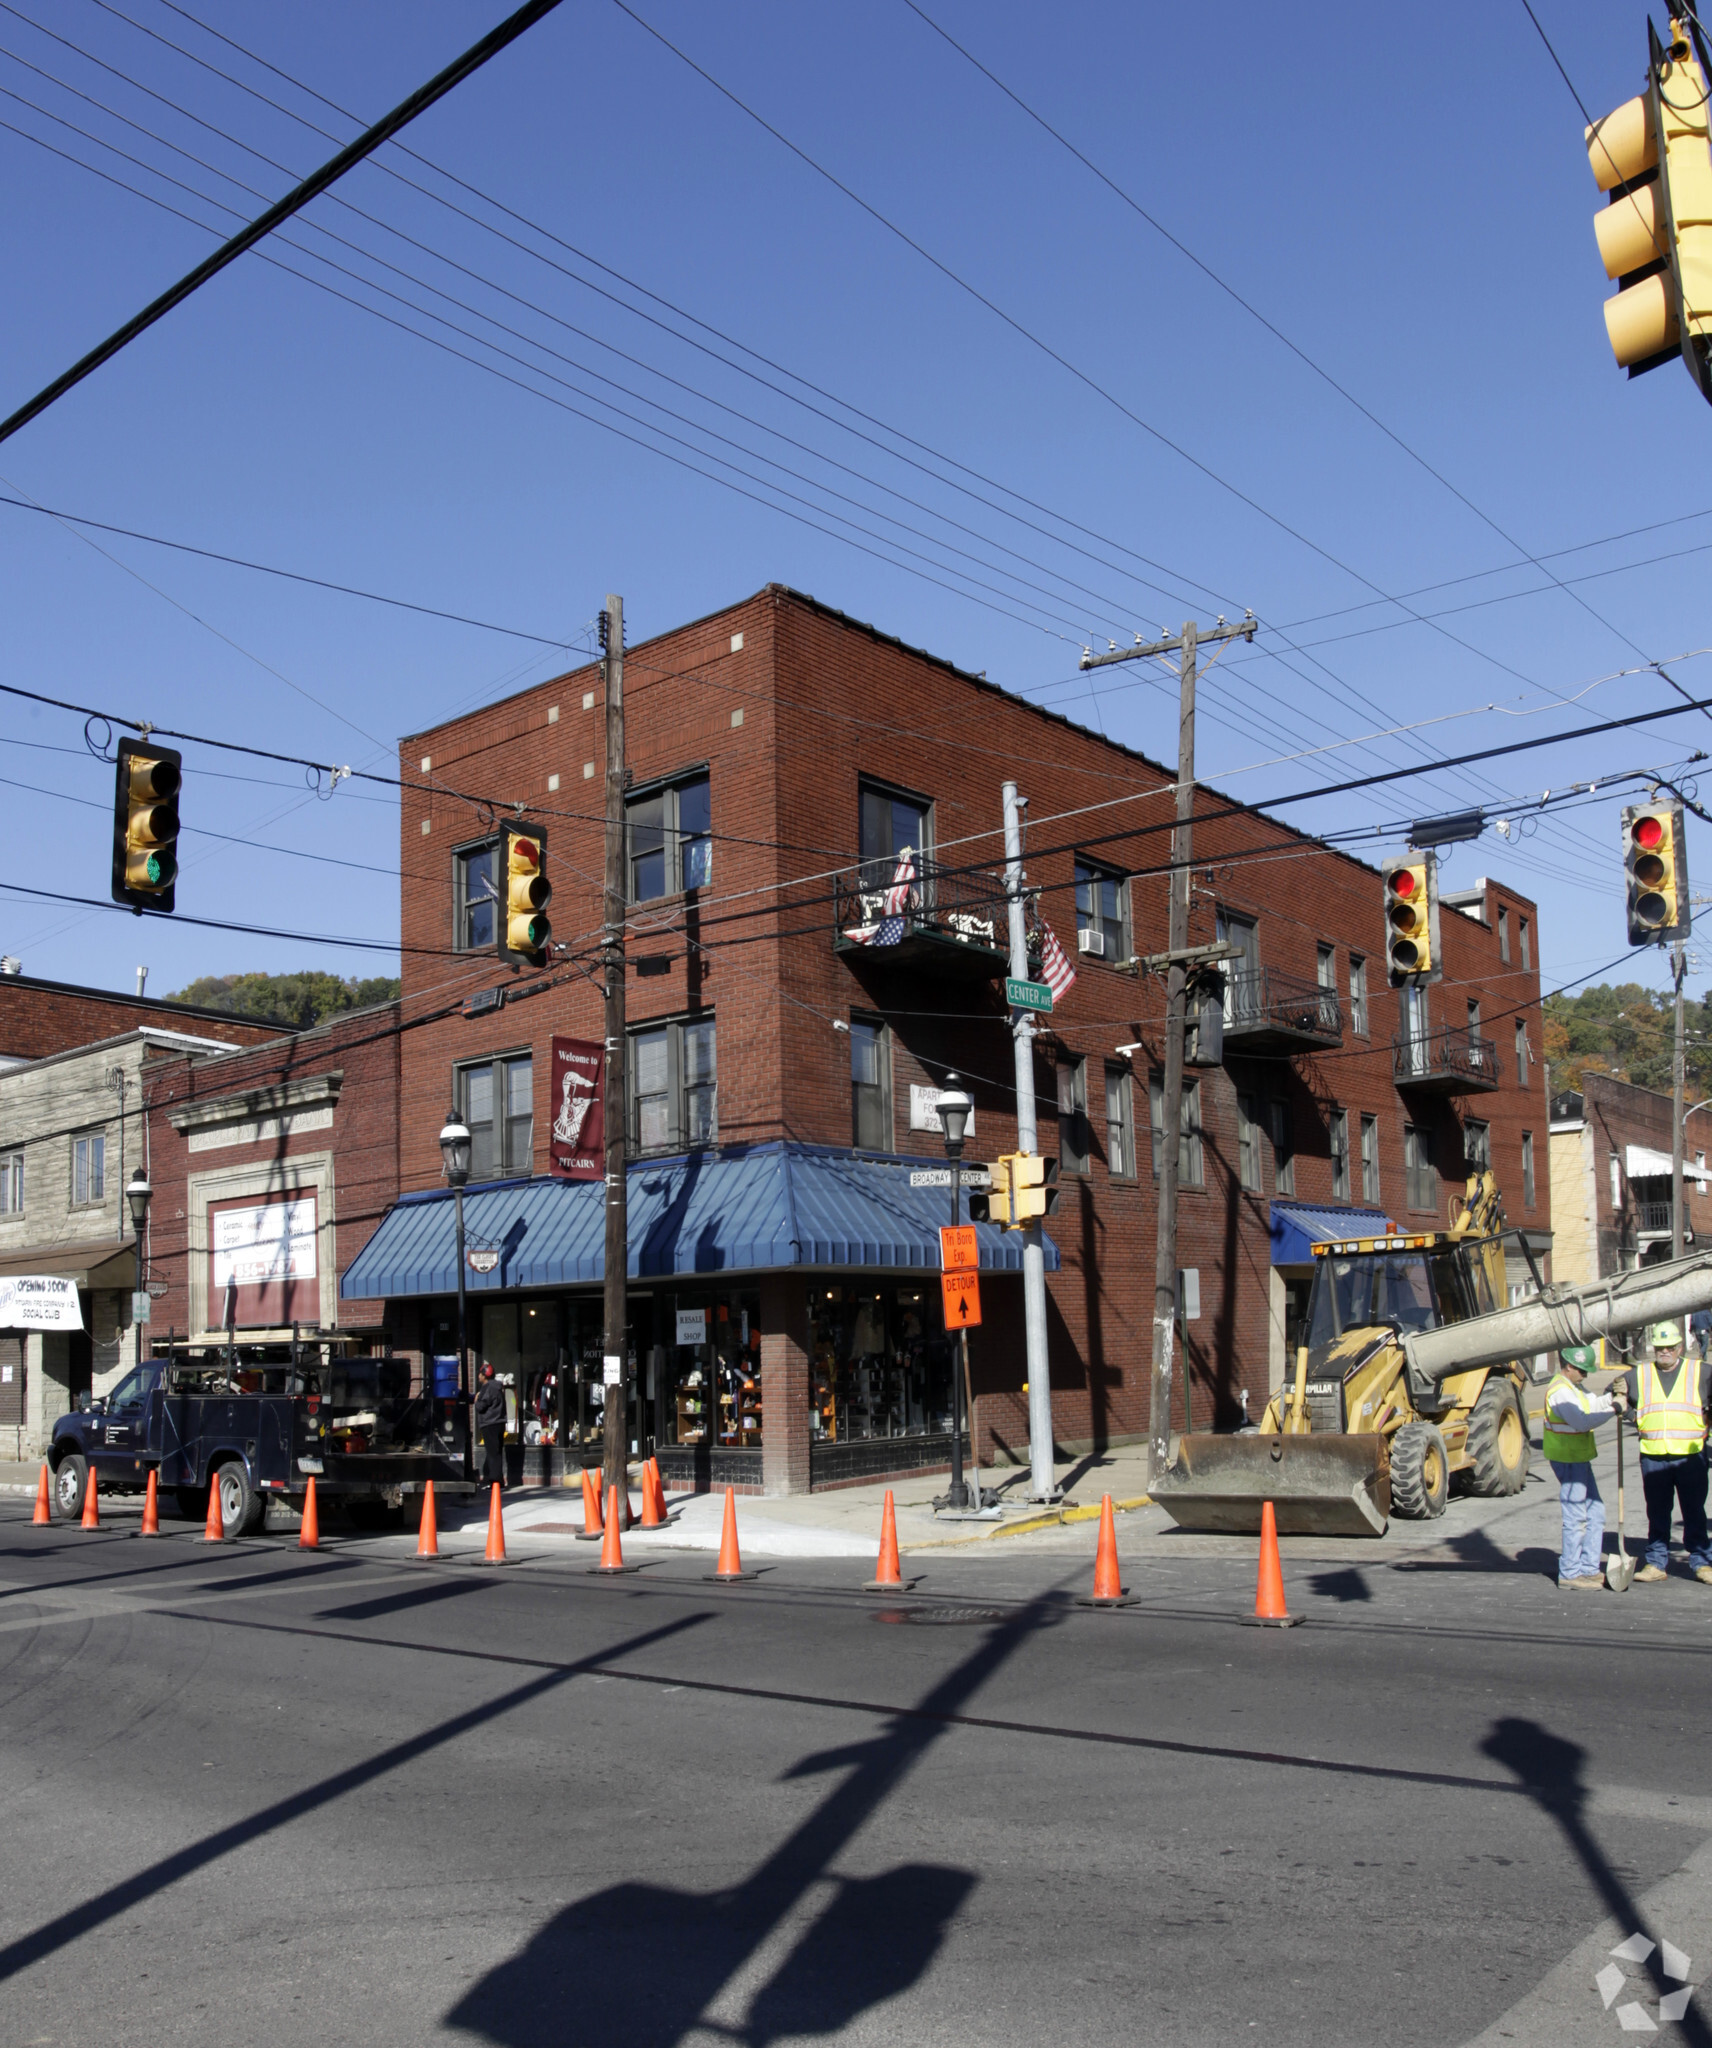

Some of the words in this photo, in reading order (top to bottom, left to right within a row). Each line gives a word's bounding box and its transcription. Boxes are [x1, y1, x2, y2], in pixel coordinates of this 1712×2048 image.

[1008, 984, 1040, 1004] CENTER
[1041, 995, 1051, 1007] AVE
[558, 1050, 590, 1064] Welcome
[590, 1057, 598, 1065] to
[923, 1103, 937, 1114] FO
[558, 1157, 595, 1169] PITCAIRN
[912, 1172, 948, 1185] BROADWAY
[960, 1172, 981, 1184] CENTER
[287, 1211, 301, 1222] Vinyl
[223, 1221, 243, 1230] Ceramic
[287, 1225, 304, 1236] Wood
[223, 1235, 240, 1245] Carpet
[945, 1232, 955, 1246] Tri
[956, 1231, 973, 1246] Boro
[287, 1242, 312, 1253] Laminate
[17, 1280, 46, 1292] OPENING
[946, 1275, 976, 1292] DETOUR
[22, 1308, 43, 1319] SOCIAL
[44, 1309, 61, 1320] CLUB
[680, 1315, 703, 1324] RESALE
[683, 1332, 702, 1341] SHOP
[1290, 1384, 1333, 1394] CRPILLAR
